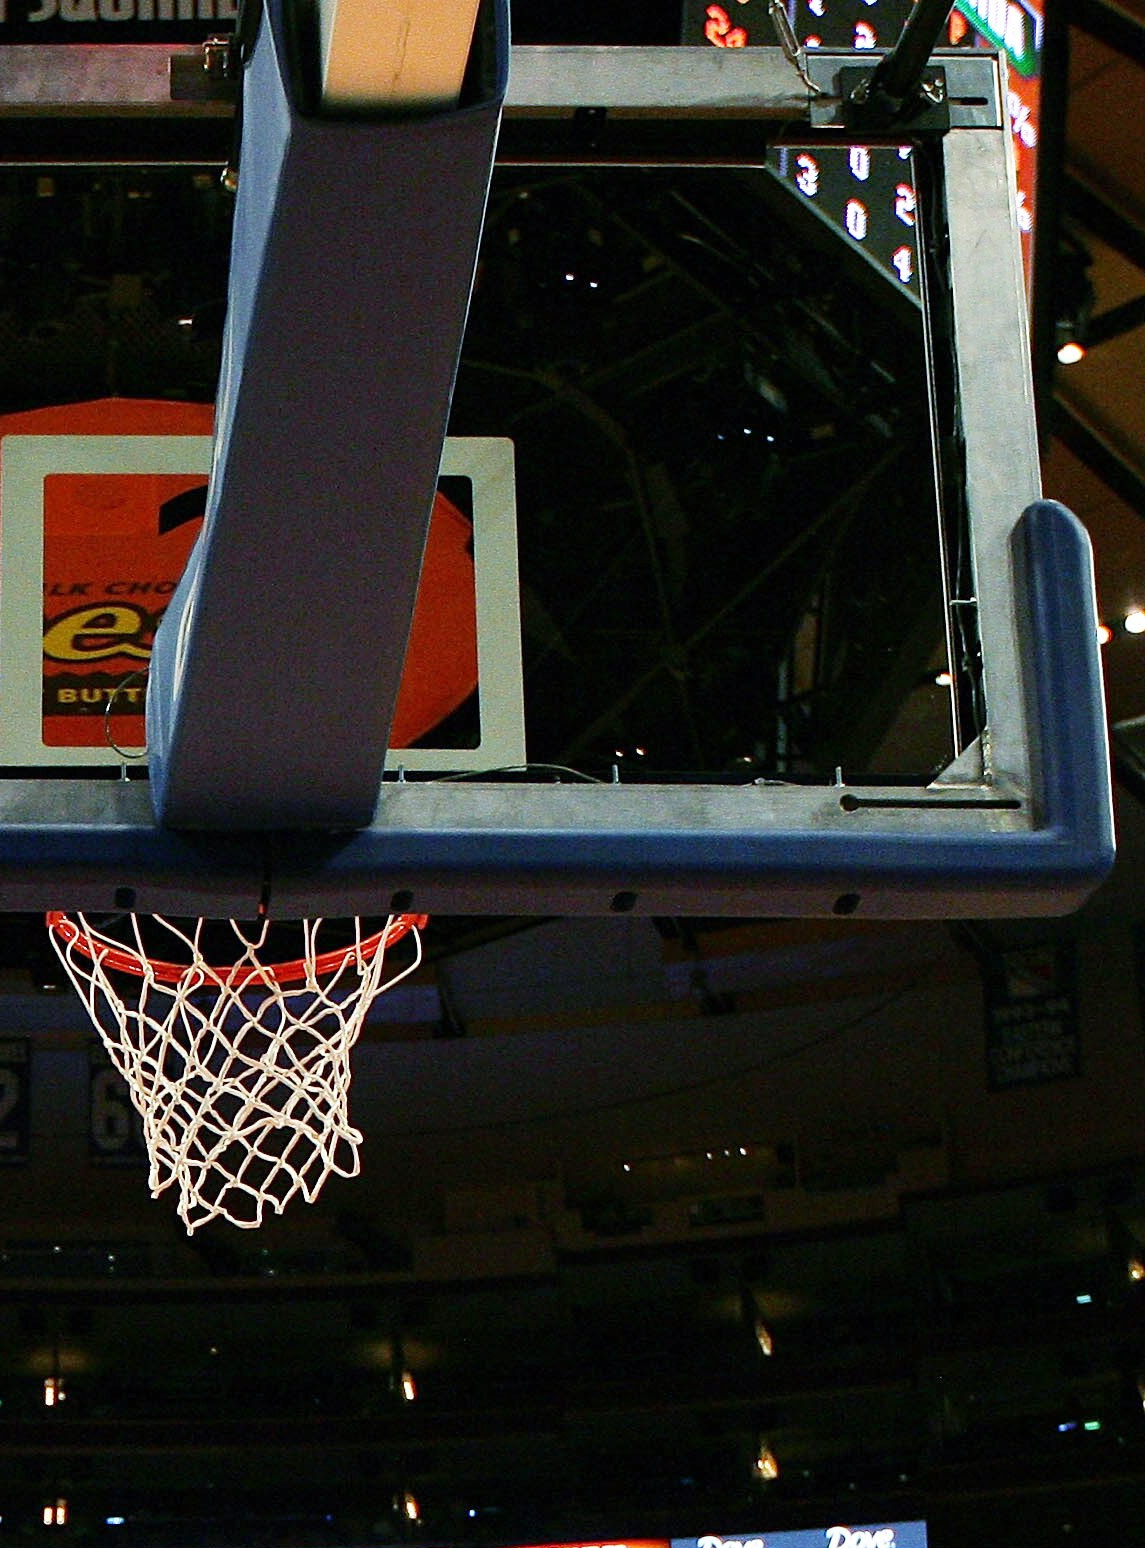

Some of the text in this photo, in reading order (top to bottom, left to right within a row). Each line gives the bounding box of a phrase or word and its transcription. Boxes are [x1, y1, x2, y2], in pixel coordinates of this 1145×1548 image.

[842, 197, 870, 241] 0
[104, 580, 179, 596] CHO
[57, 687, 142, 704] BUTT
[91, 1070, 133, 1150] 6
